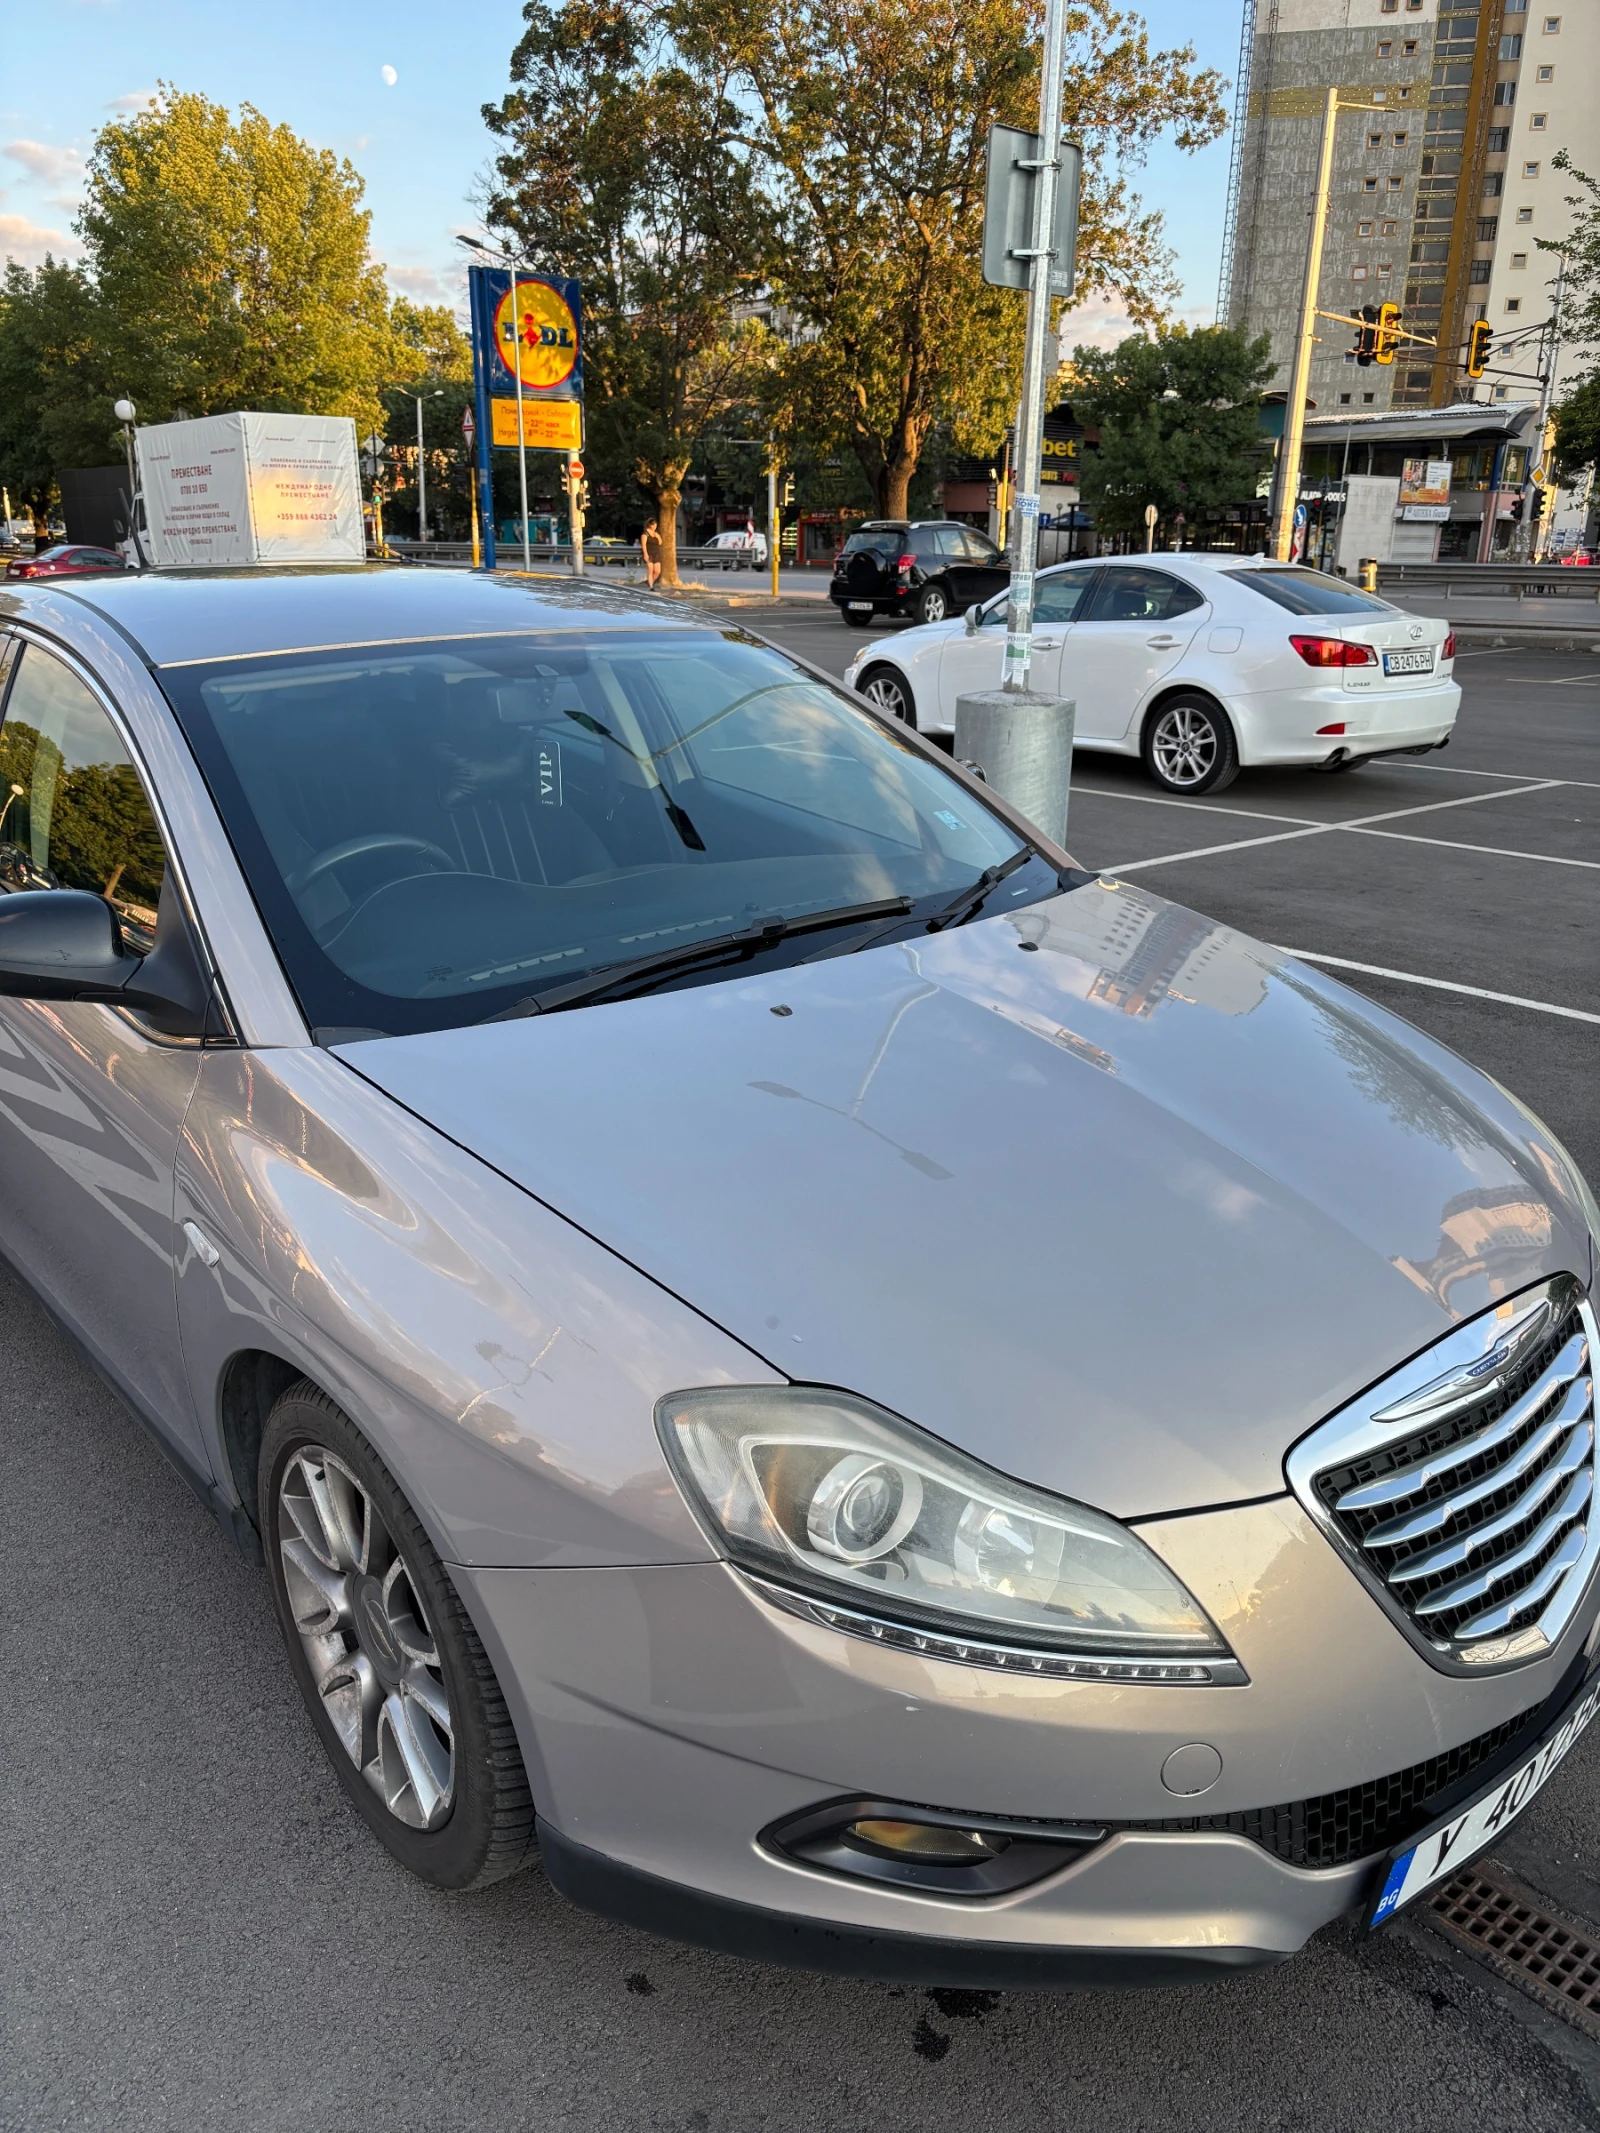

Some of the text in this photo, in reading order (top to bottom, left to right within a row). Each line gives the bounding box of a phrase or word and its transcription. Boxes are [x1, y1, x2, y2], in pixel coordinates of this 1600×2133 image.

[171, 464, 212, 479] ПРЕМЕСТВАНЕ
[1389, 654, 1431, 670] CB 2476 PH
[540, 752, 553, 796] VIP
[1472, 1350, 1506, 1376] CHRYSLER
[1376, 1889, 1399, 1914] BG
